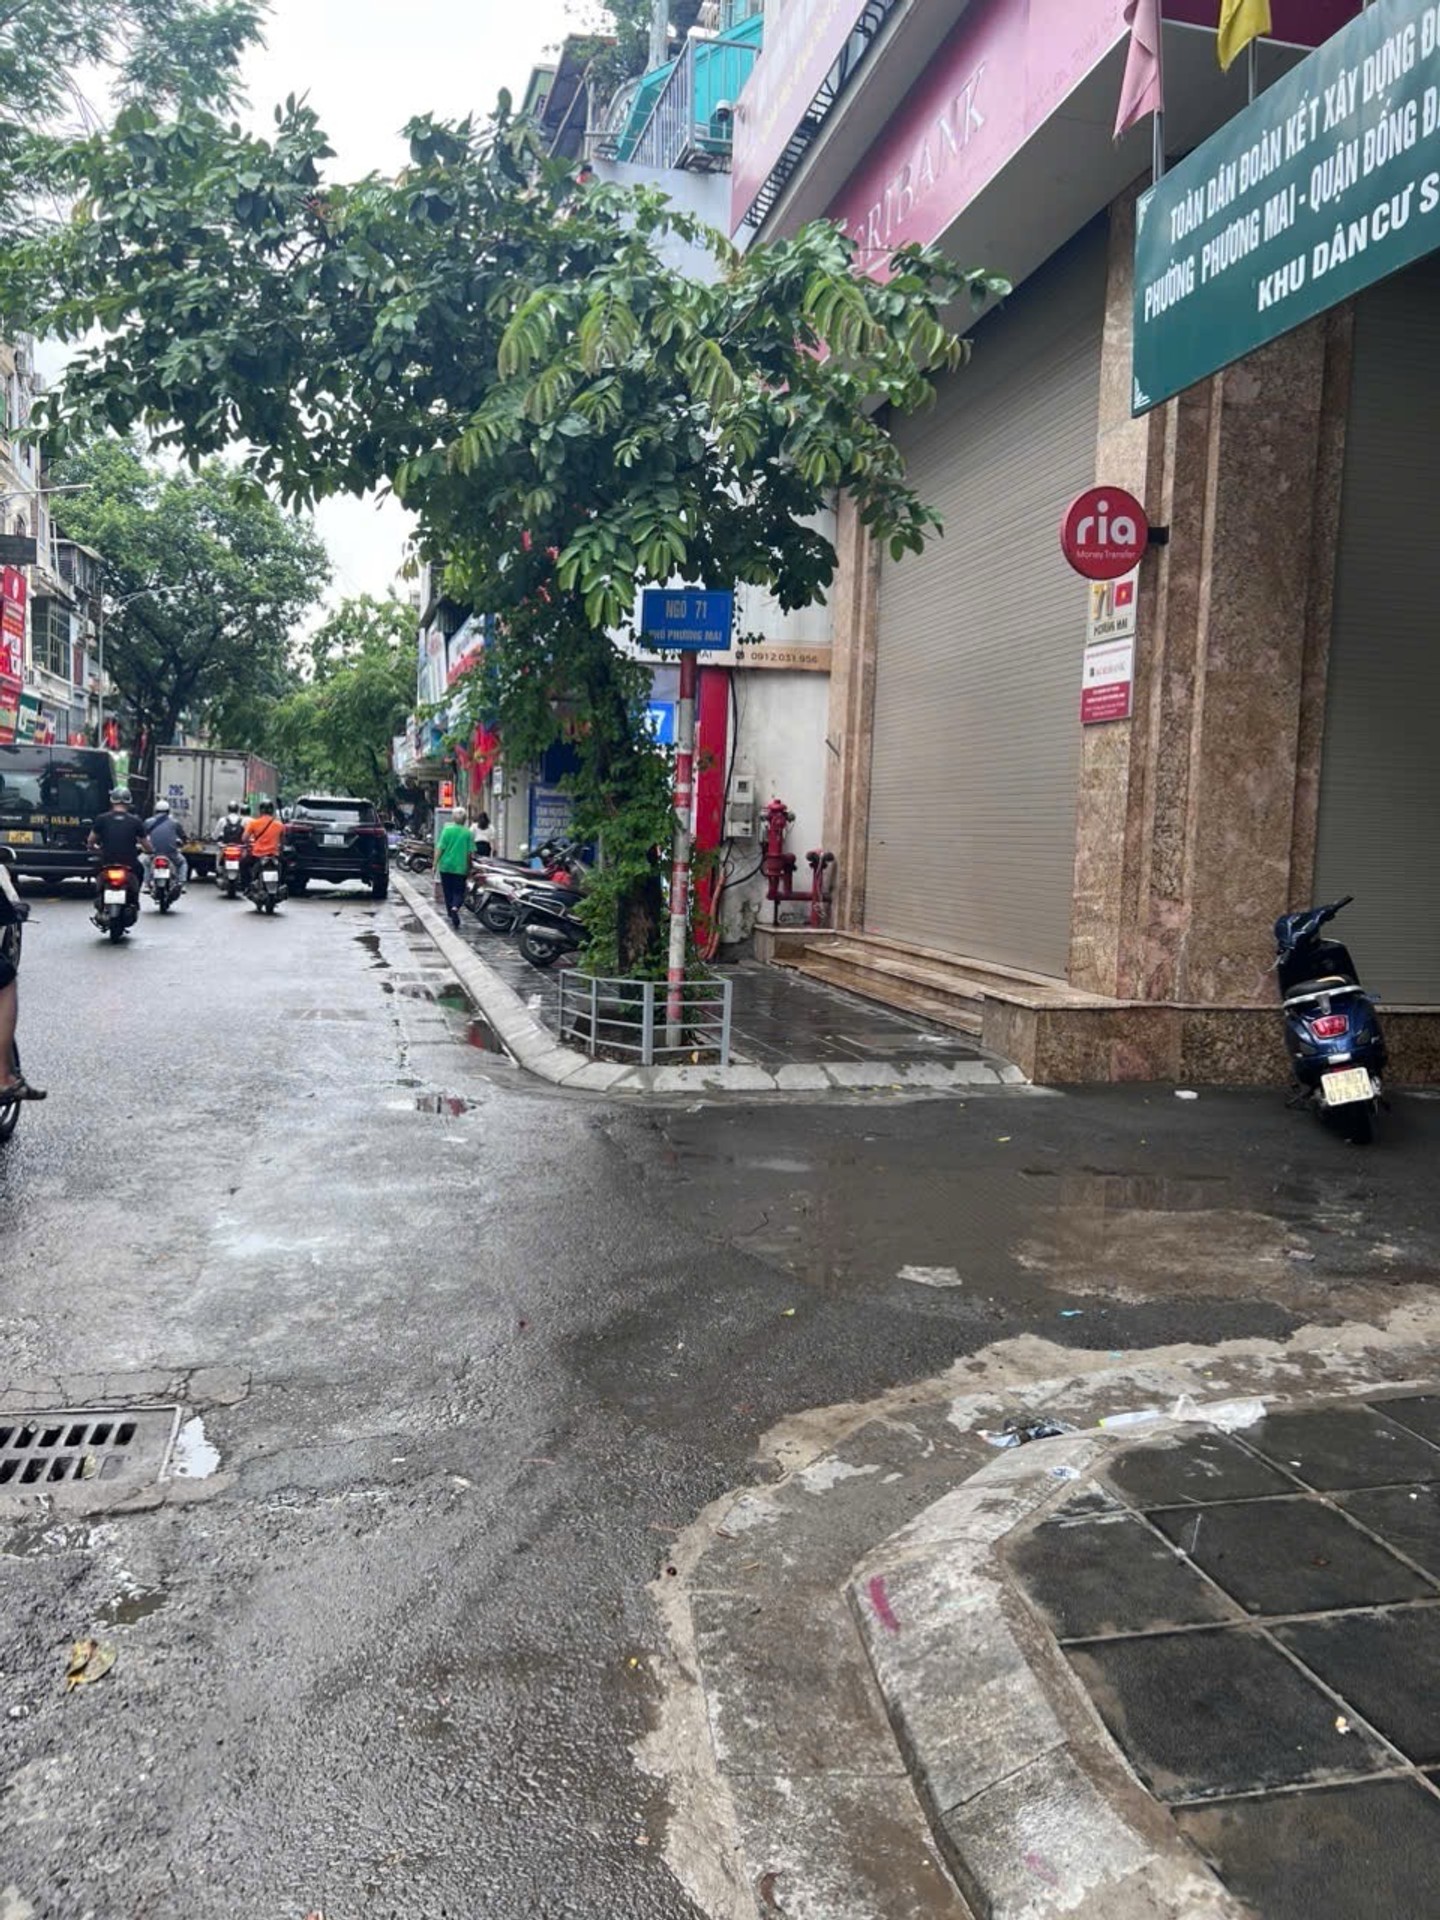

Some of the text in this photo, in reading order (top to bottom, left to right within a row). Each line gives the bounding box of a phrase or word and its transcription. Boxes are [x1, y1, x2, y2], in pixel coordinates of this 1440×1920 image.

[852, 61, 986, 267] GRIBANK
[1170, 186, 1204, 244] TOÀN
[1207, 157, 1237, 218] DÂN
[1239, 128, 1281, 196] ĐOÀN
[1286, 90, 1319, 160] KẾT
[1323, 64, 1359, 132] XÂY
[1363, 22, 1415, 103] DỰNG
[1144, 256, 1194, 323] PHƯỜNG
[1201, 215, 1259, 284] PHƯƠNG
[1263, 183, 1296, 248] MAI
[1310, 142, 1358, 212] QUẬN
[1363, 97, 1417, 177] ĐỐNG
[1257, 260, 1305, 313] KHU
[1312, 225, 1368, 281] DÂN
[1371, 181, 1413, 243] CƯ
[1076, 500, 1137, 545] ria
[1076, 550, 1104, 560] Money
[695, 599, 708, 619] 71
[704, 630, 723, 642] MAI
